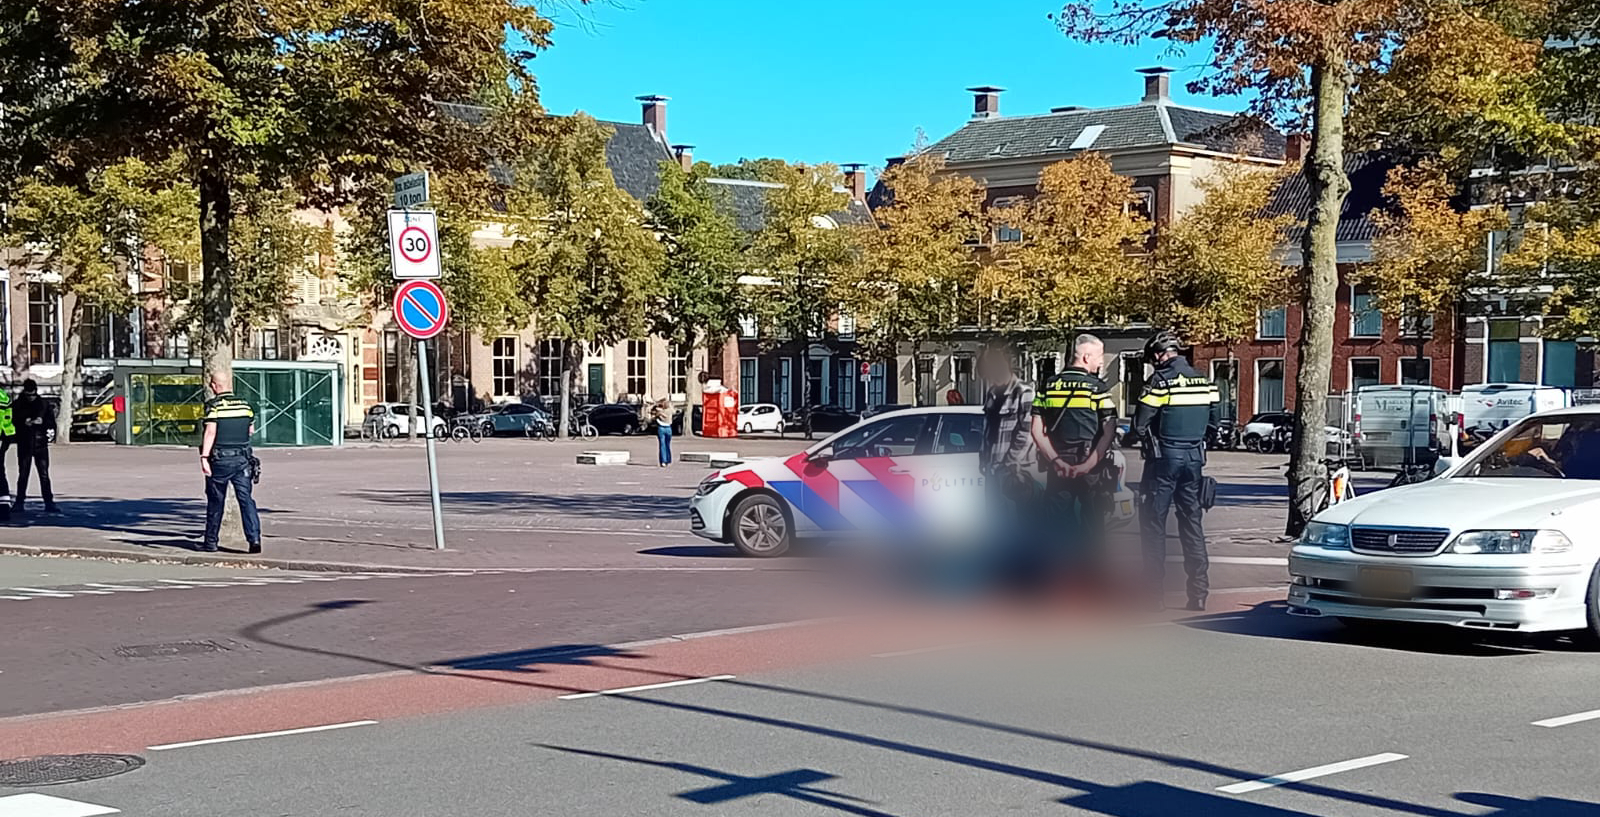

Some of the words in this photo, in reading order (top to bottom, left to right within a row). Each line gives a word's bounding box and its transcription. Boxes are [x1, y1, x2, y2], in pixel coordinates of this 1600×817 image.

[400, 194, 408, 206] 10
[410, 193, 421, 205] ton
[405, 238, 426, 252] 30
[922, 474, 984, 491] POLITIE
